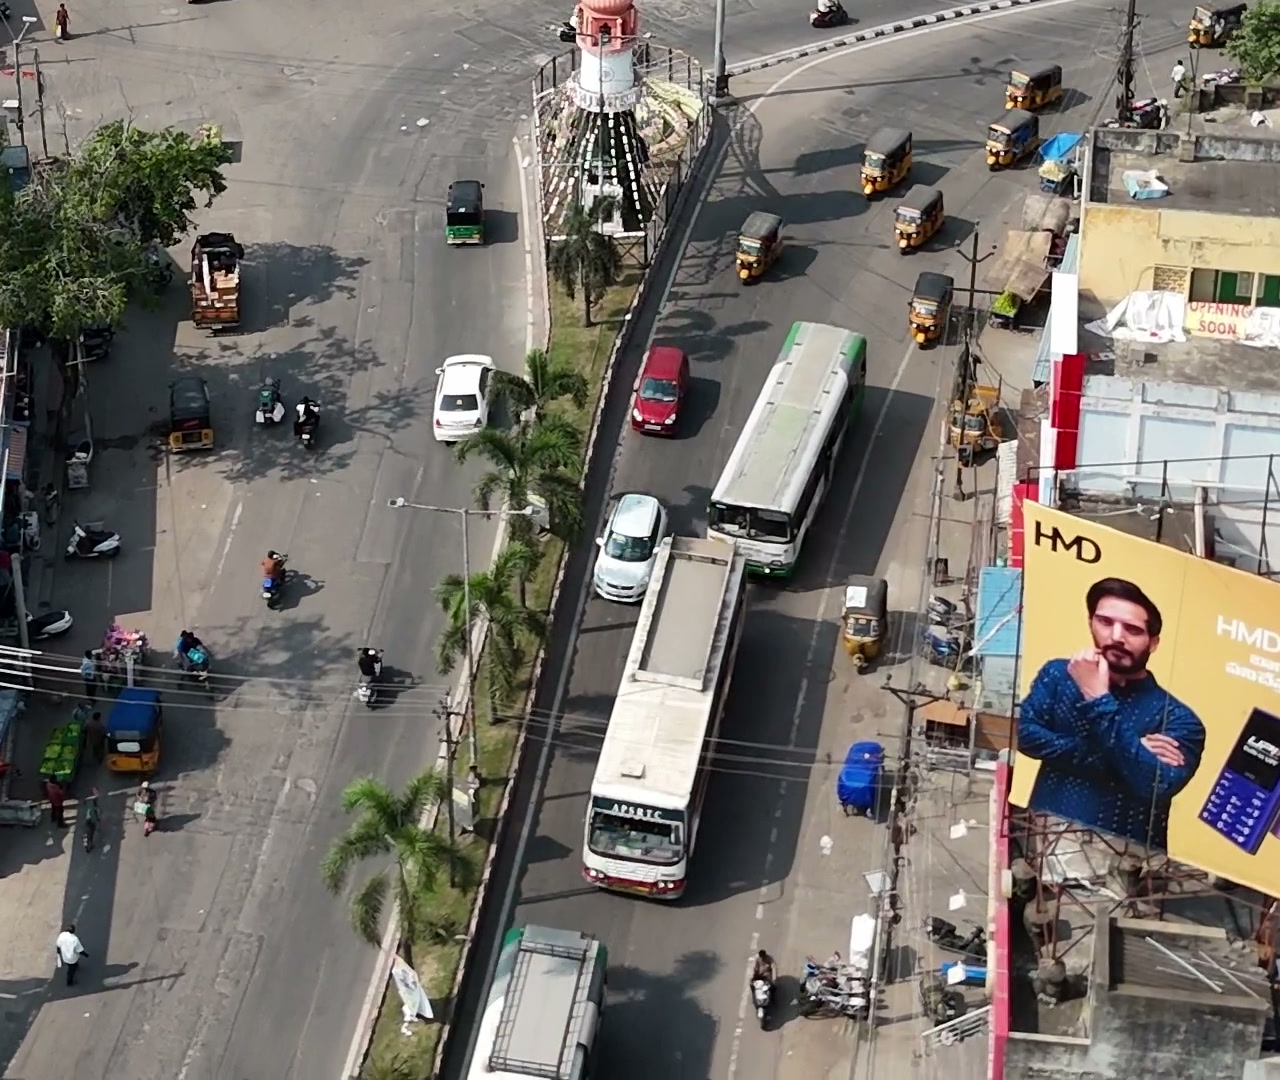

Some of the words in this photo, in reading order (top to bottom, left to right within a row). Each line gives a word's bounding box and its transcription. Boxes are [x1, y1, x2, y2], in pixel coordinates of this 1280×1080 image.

[1198, 321, 1237, 335] SOON
[1035, 520, 1102, 564] HMD
[612, 803, 662, 819] APSRTC
